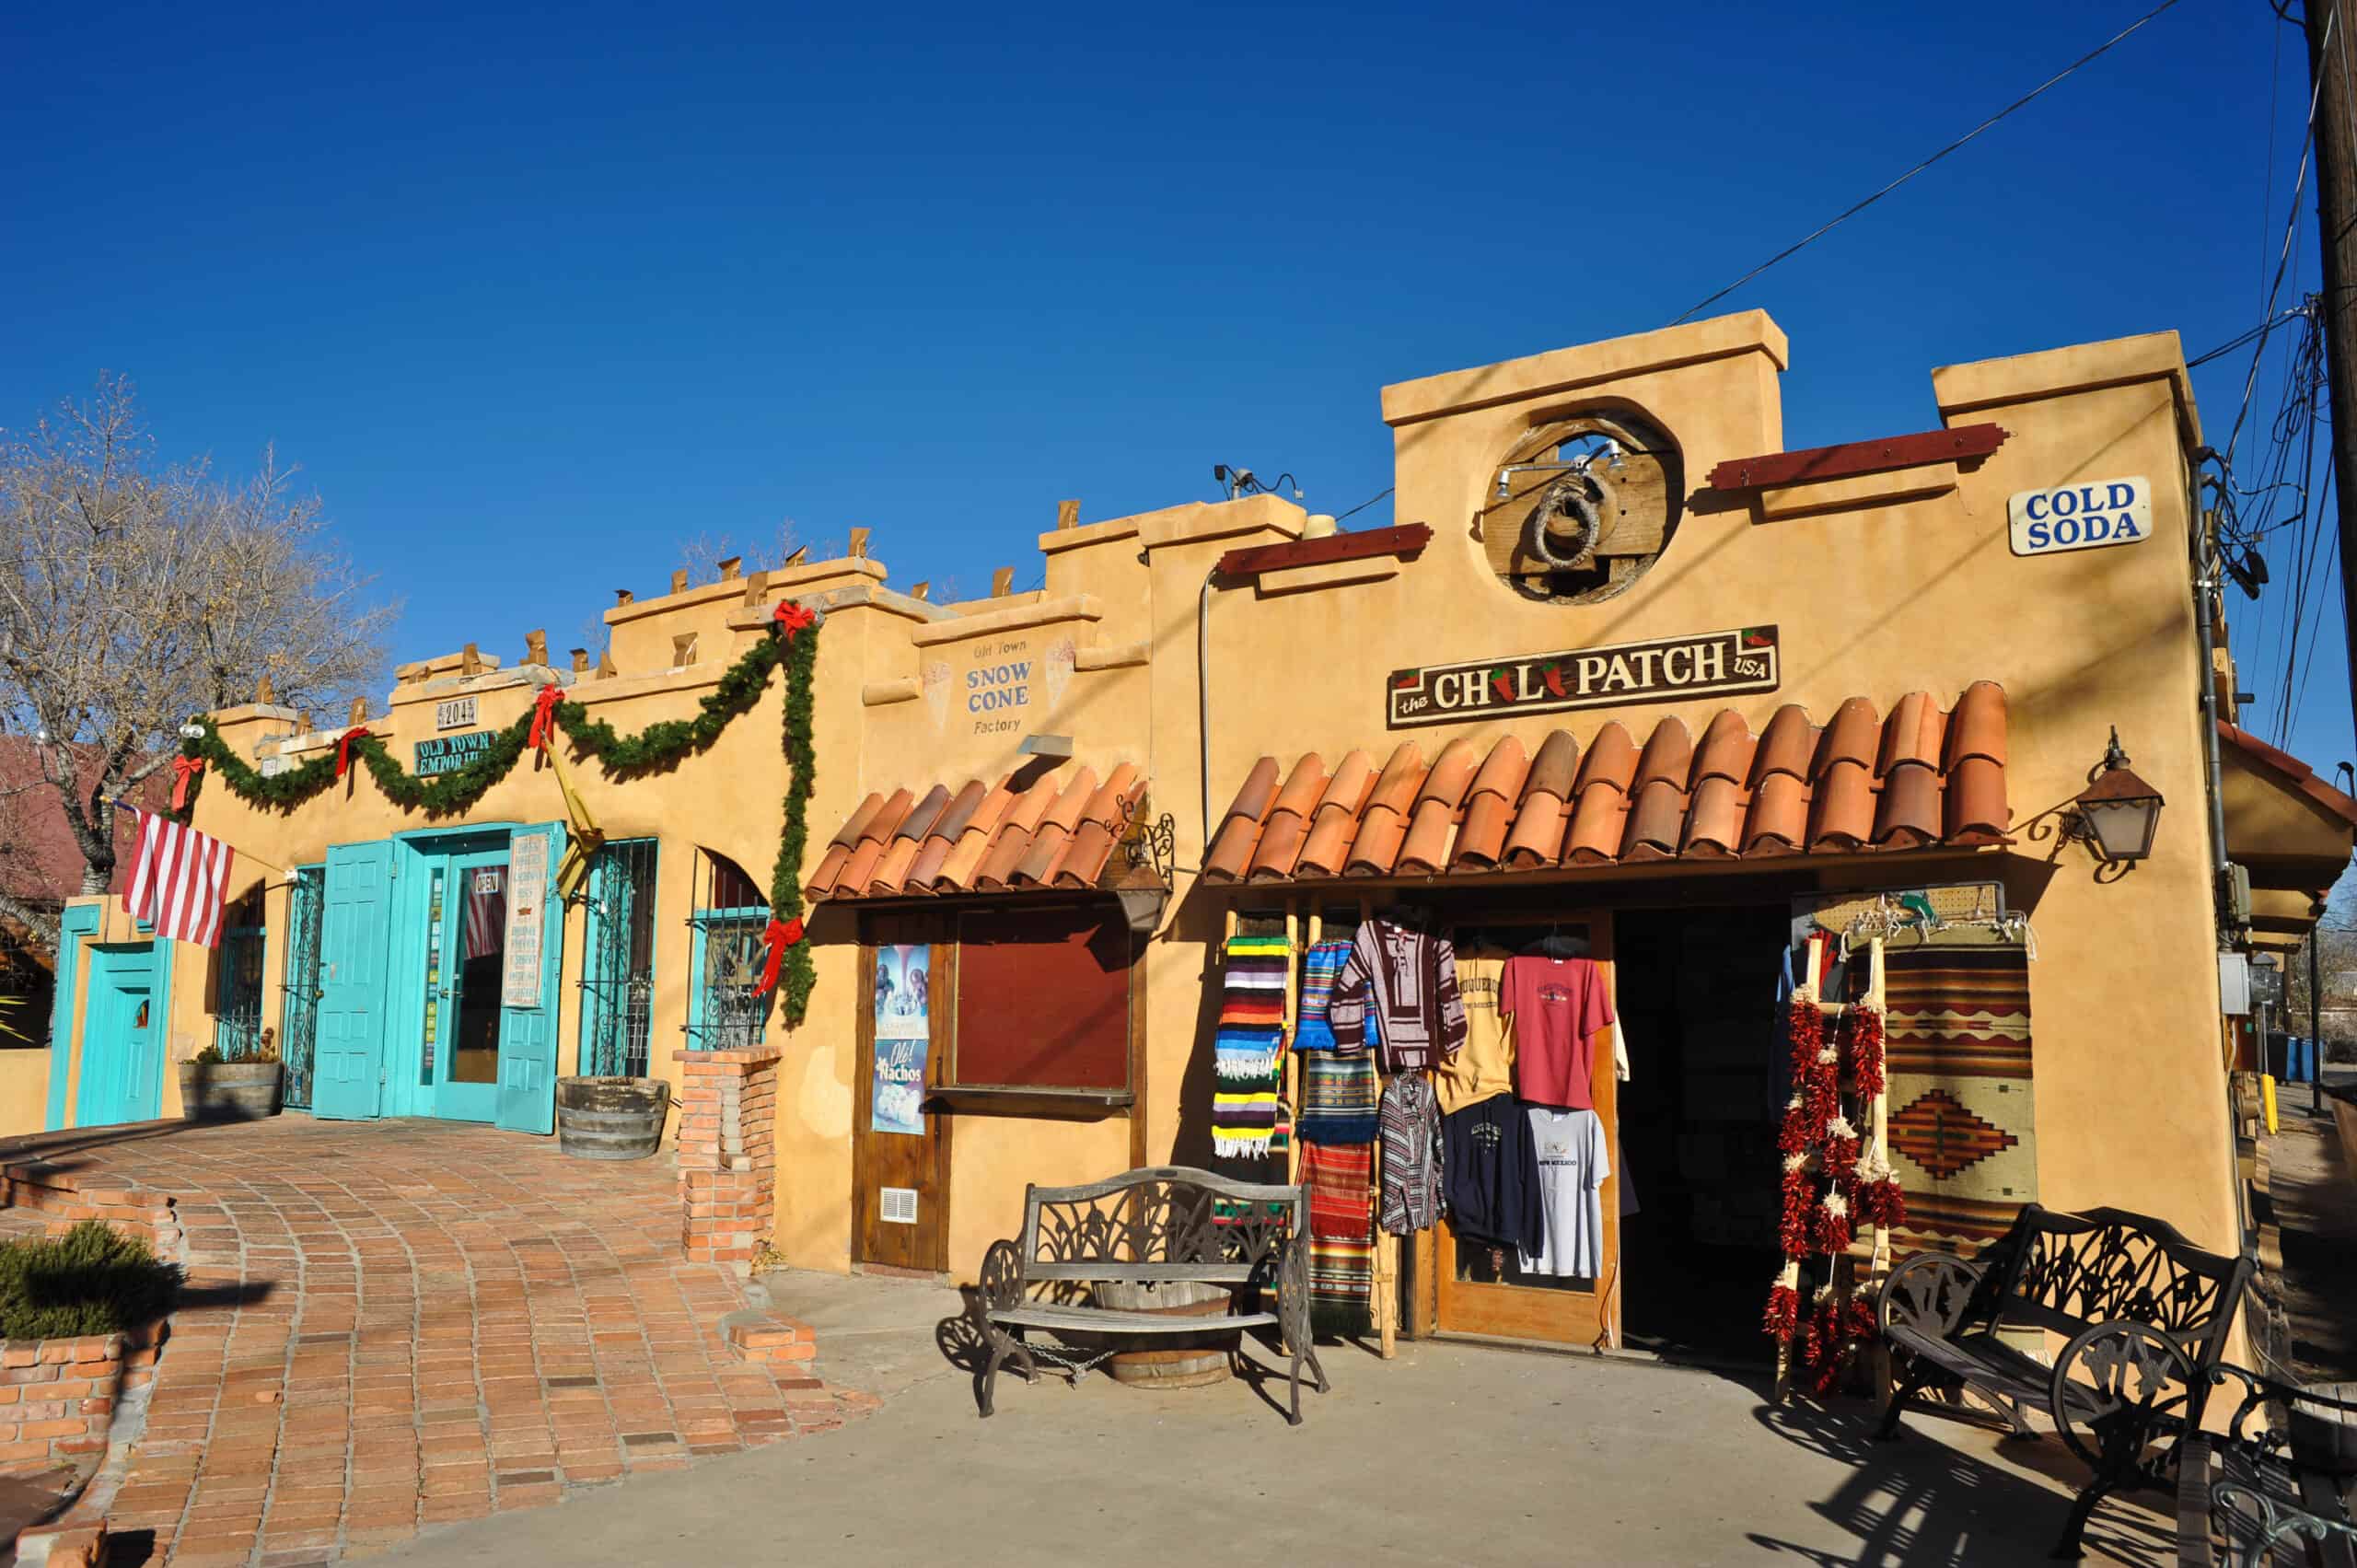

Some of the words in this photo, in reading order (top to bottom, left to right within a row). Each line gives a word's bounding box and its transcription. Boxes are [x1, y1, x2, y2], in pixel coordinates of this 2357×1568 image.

[2026, 483, 2135, 520] COLD
[2028, 513, 2141, 549] SODA
[973, 644, 992, 658] Old
[999, 640, 1027, 656] Town
[967, 662, 1032, 689] SNOW
[1399, 695, 1428, 714] the
[1575, 642, 1727, 695] PATCH
[1733, 657, 1766, 679] USA
[969, 686, 1029, 713] CONE
[974, 718, 1021, 735] Factory
[420, 738, 445, 758] OLD
[447, 732, 490, 753] TOWN
[477, 874, 497, 891] OPEN
[879, 1063, 922, 1082] Nachos
